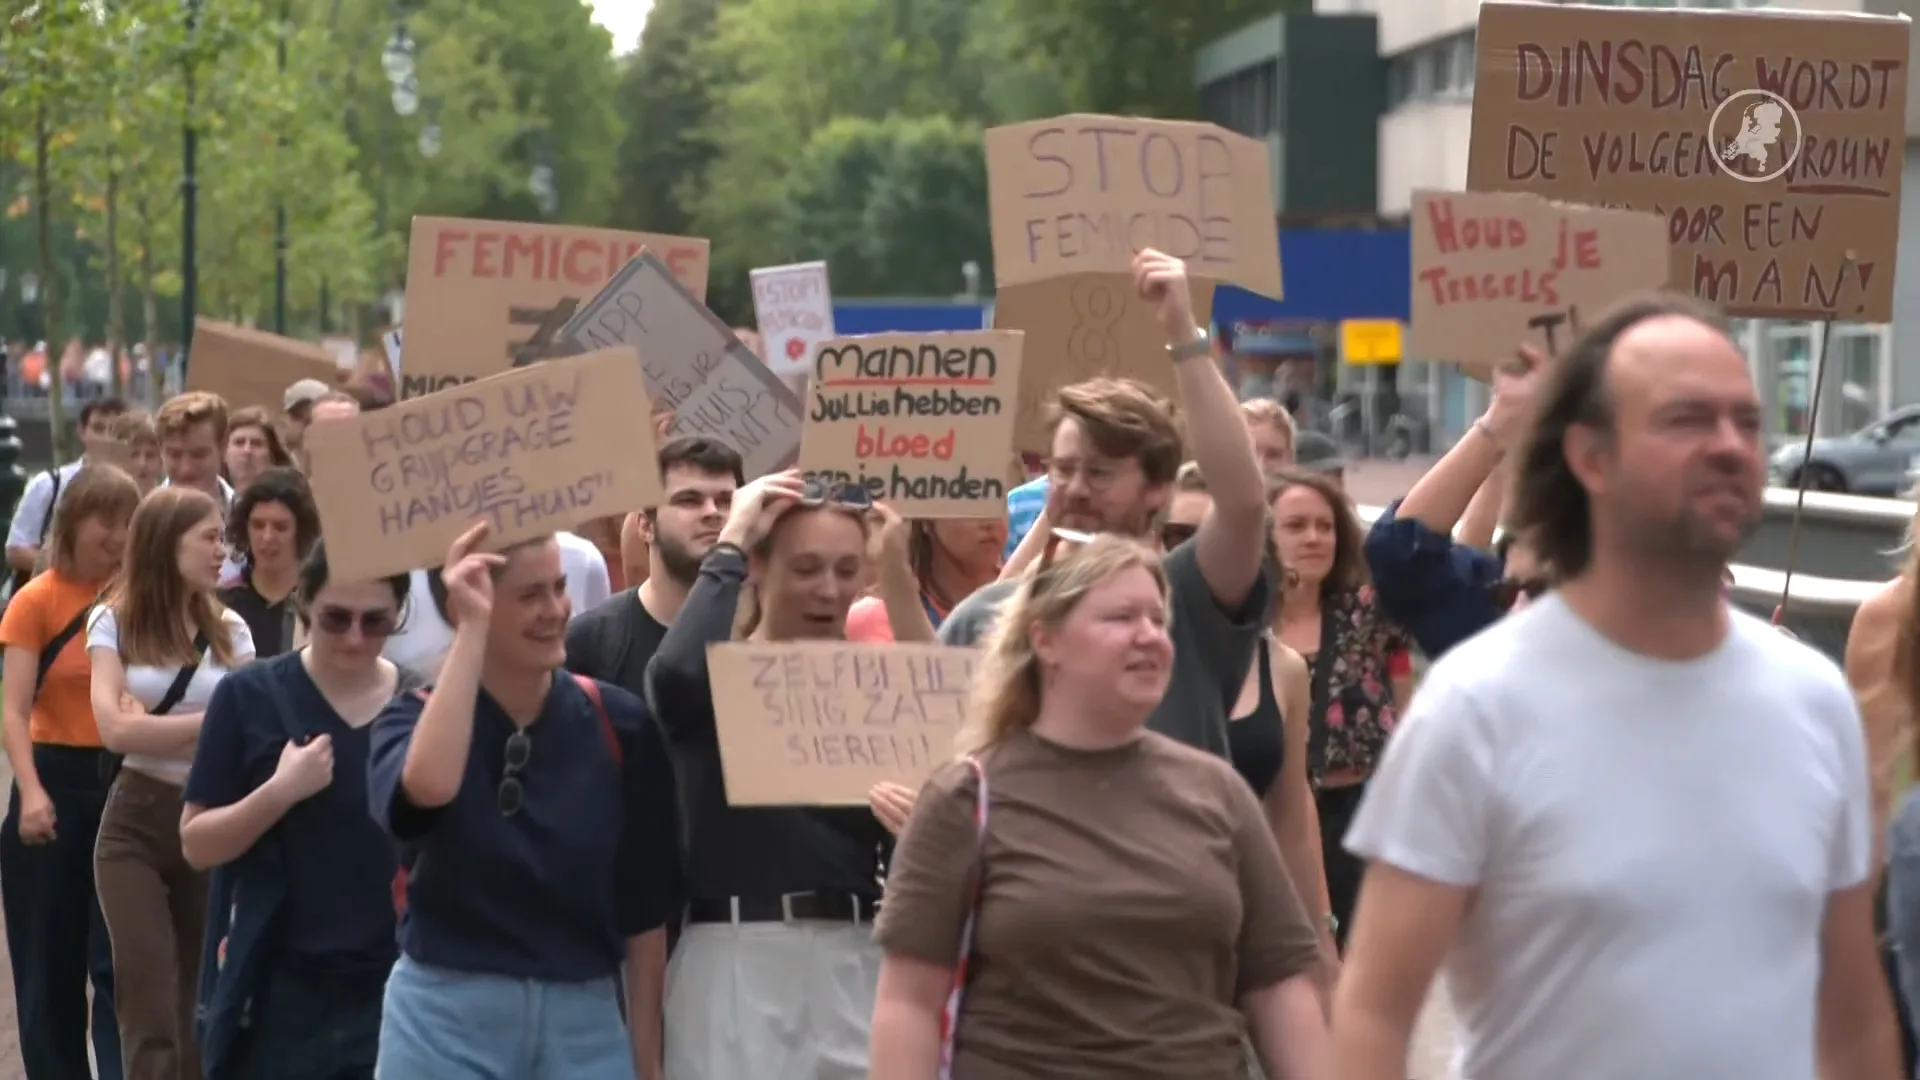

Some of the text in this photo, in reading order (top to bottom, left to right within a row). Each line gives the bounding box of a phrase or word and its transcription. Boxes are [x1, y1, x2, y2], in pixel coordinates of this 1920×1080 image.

[1517, 39, 1902, 113] DINSDAG WORDT
[1021, 126, 1236, 208] STOP
[1507, 125, 1557, 181] DE
[1025, 210, 1236, 264] FEMICIDE
[1655, 202, 1824, 249] OOR EEN
[1694, 255, 1875, 314] MAN!
[361, 368, 587, 459] HOUD UW
[894, 385, 1001, 417] hebben
[891, 463, 1003, 500] handen
